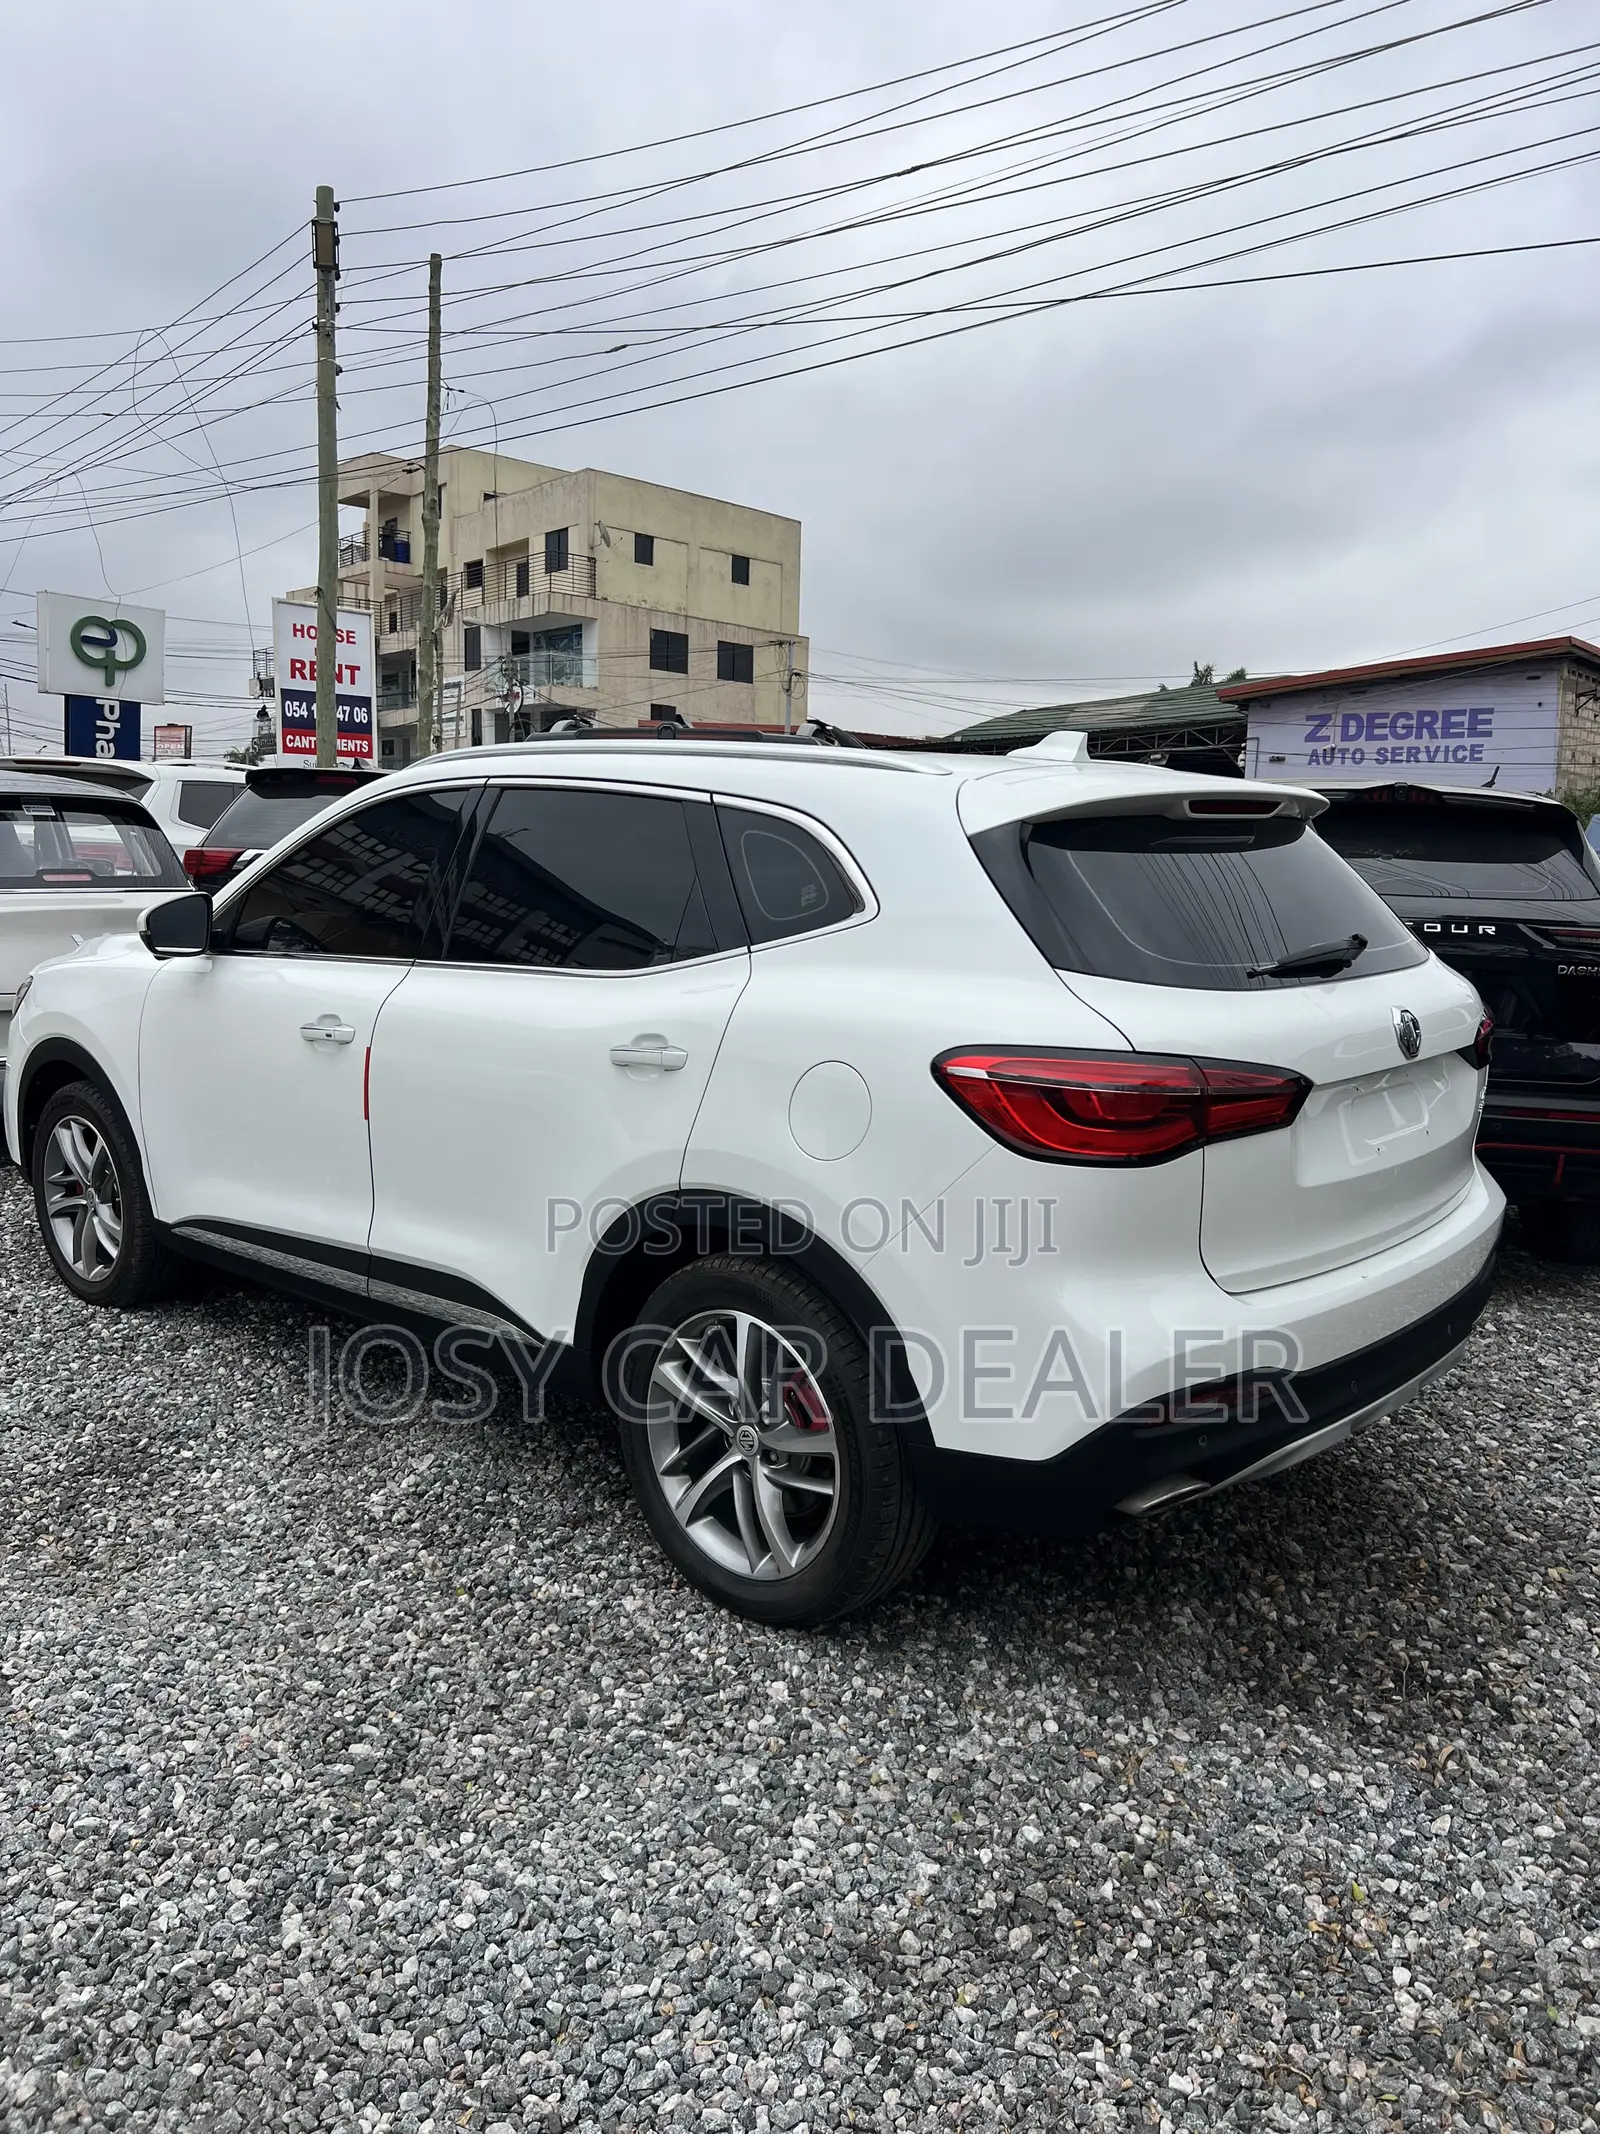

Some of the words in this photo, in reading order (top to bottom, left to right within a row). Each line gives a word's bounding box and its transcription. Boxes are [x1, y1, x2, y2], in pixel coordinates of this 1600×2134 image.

[292, 623, 356, 645] HOSE
[285, 700, 308, 718] 054
[336, 706, 351, 722] 47
[353, 707, 368, 723] 06
[1304, 714, 1333, 743] Z
[1340, 707, 1495, 742] DEGREE
[1307, 748, 1366, 766] AUTO
[1375, 744, 1485, 766] SERVICE
[1405, 922, 1496, 935] OUR
